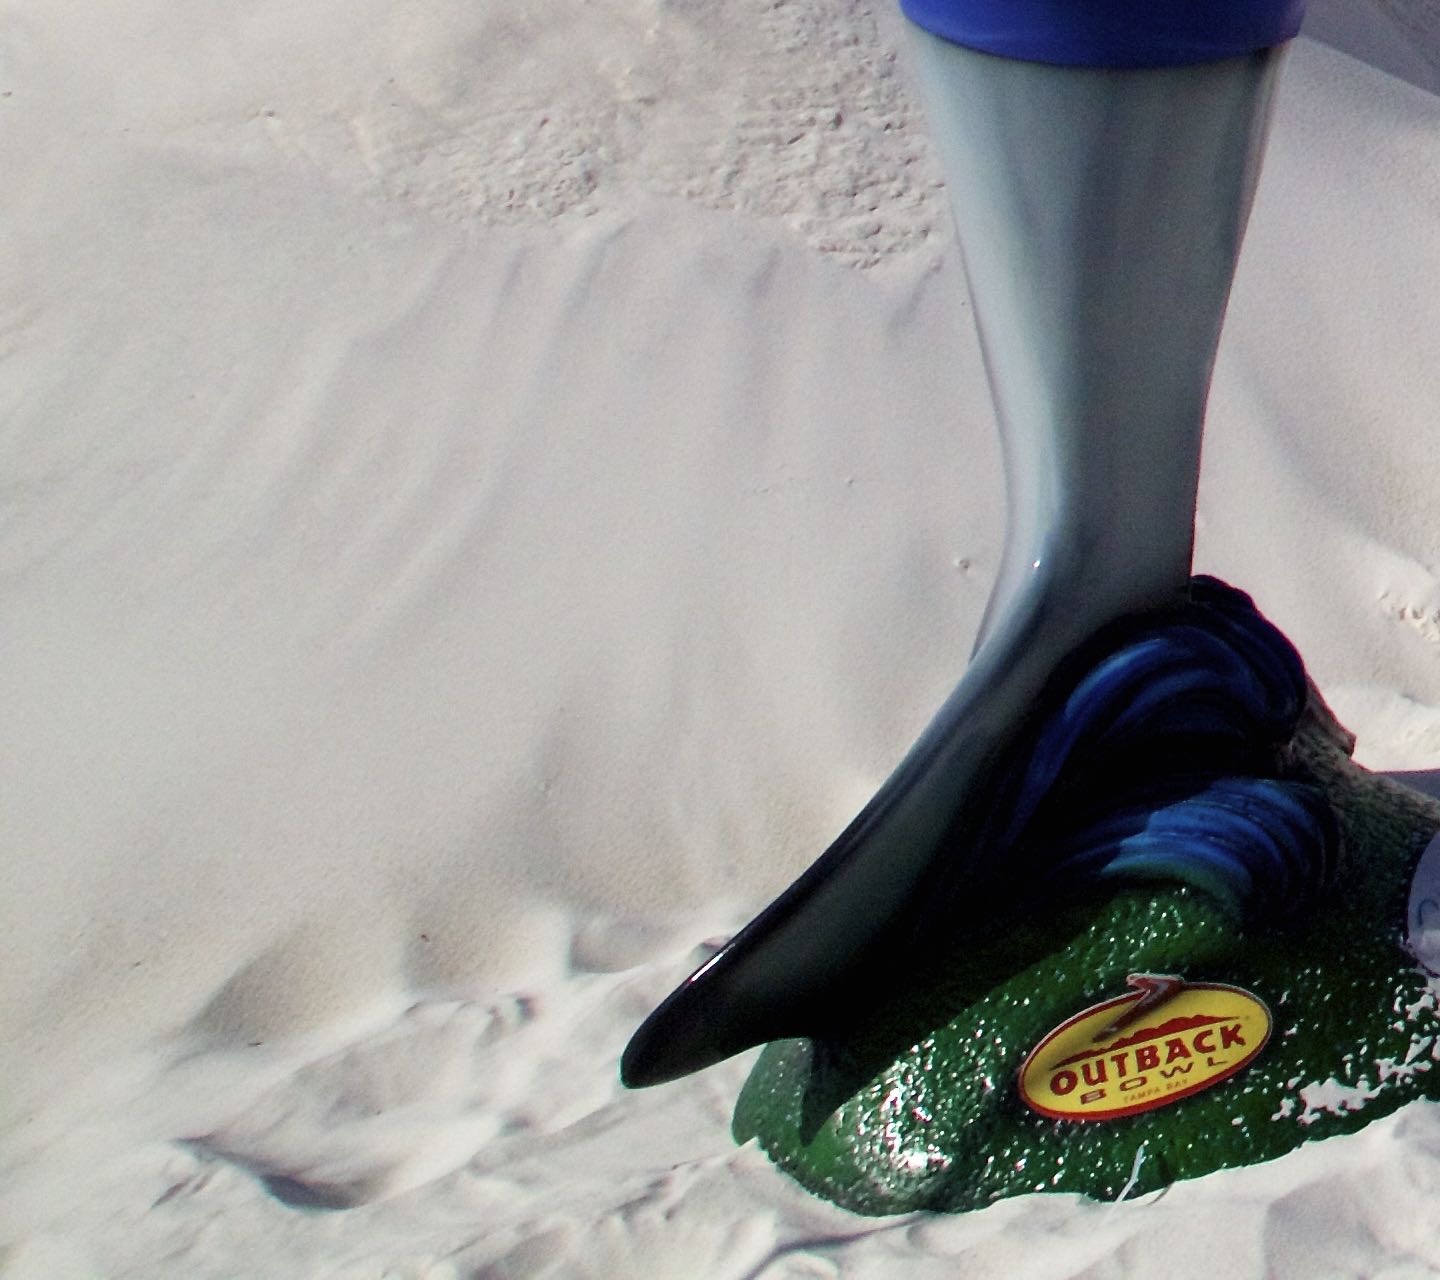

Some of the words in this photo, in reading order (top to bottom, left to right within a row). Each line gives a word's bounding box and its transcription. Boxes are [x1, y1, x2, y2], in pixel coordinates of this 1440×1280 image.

[1050, 1024, 1246, 1096] OUTBACK
[1080, 1057, 1228, 1105] BOWL
[1124, 1086, 1161, 1104] TAMPA
